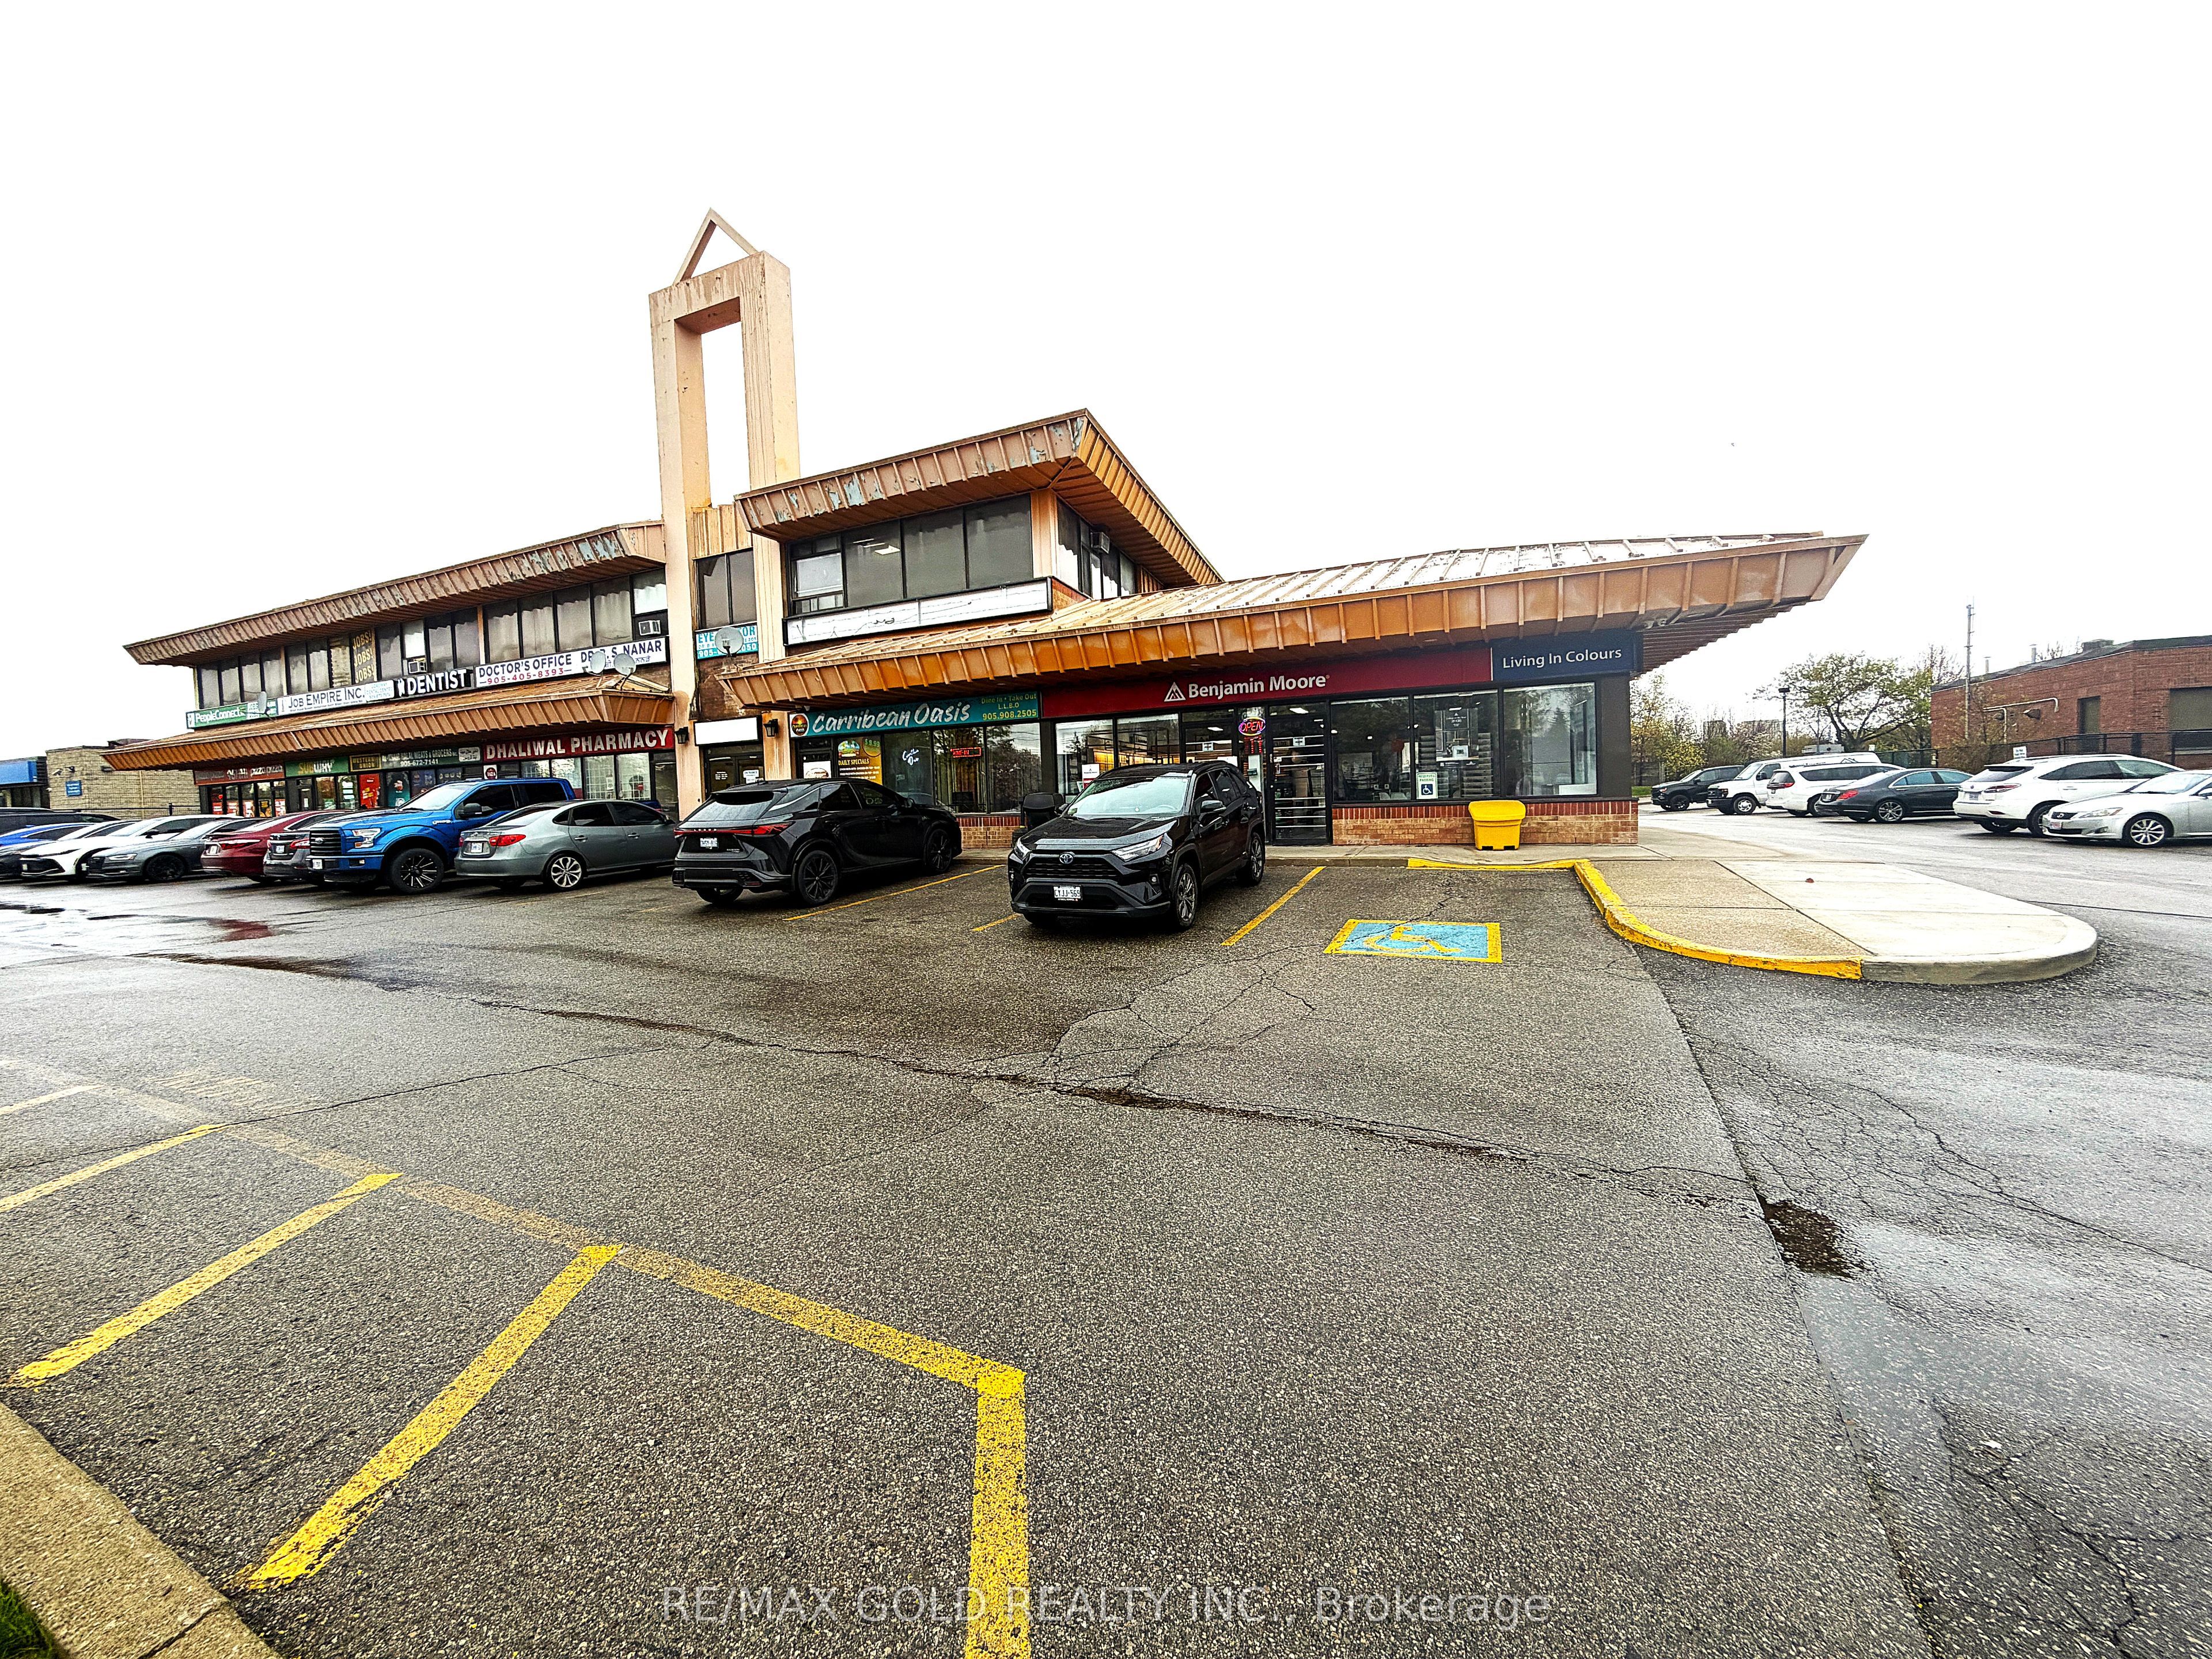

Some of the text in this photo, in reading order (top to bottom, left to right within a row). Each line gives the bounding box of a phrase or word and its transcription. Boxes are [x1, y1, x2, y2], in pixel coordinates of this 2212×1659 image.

[353, 630, 372, 650] JOBS!
[698, 632, 714, 643] EYE
[354, 647, 373, 667] JOBS!
[623, 640, 662, 656] NANAR
[479, 654, 572, 678] DOCTOR'S OFFICE
[1503, 649, 1622, 668] Living In Colours
[355, 664, 374, 684] JOBS!
[407, 670, 465, 695] DENTIST
[306, 691, 342, 706] EMPIRE
[345, 688, 365, 700] INC.
[1188, 675, 1326, 700] Benjamin Moore
[812, 702, 971, 733] Carribean Oasis
[982, 709, 1037, 721] 905.908.2505
[1240, 721, 1264, 732] OPEN
[432, 749, 452, 758] GROCERS
[486, 739, 566, 760] DHALIWAL
[570, 729, 668, 753] PHARMACY
[298, 760, 332, 775] SUBWAY
[400, 758, 438, 767] 905-672-7141
